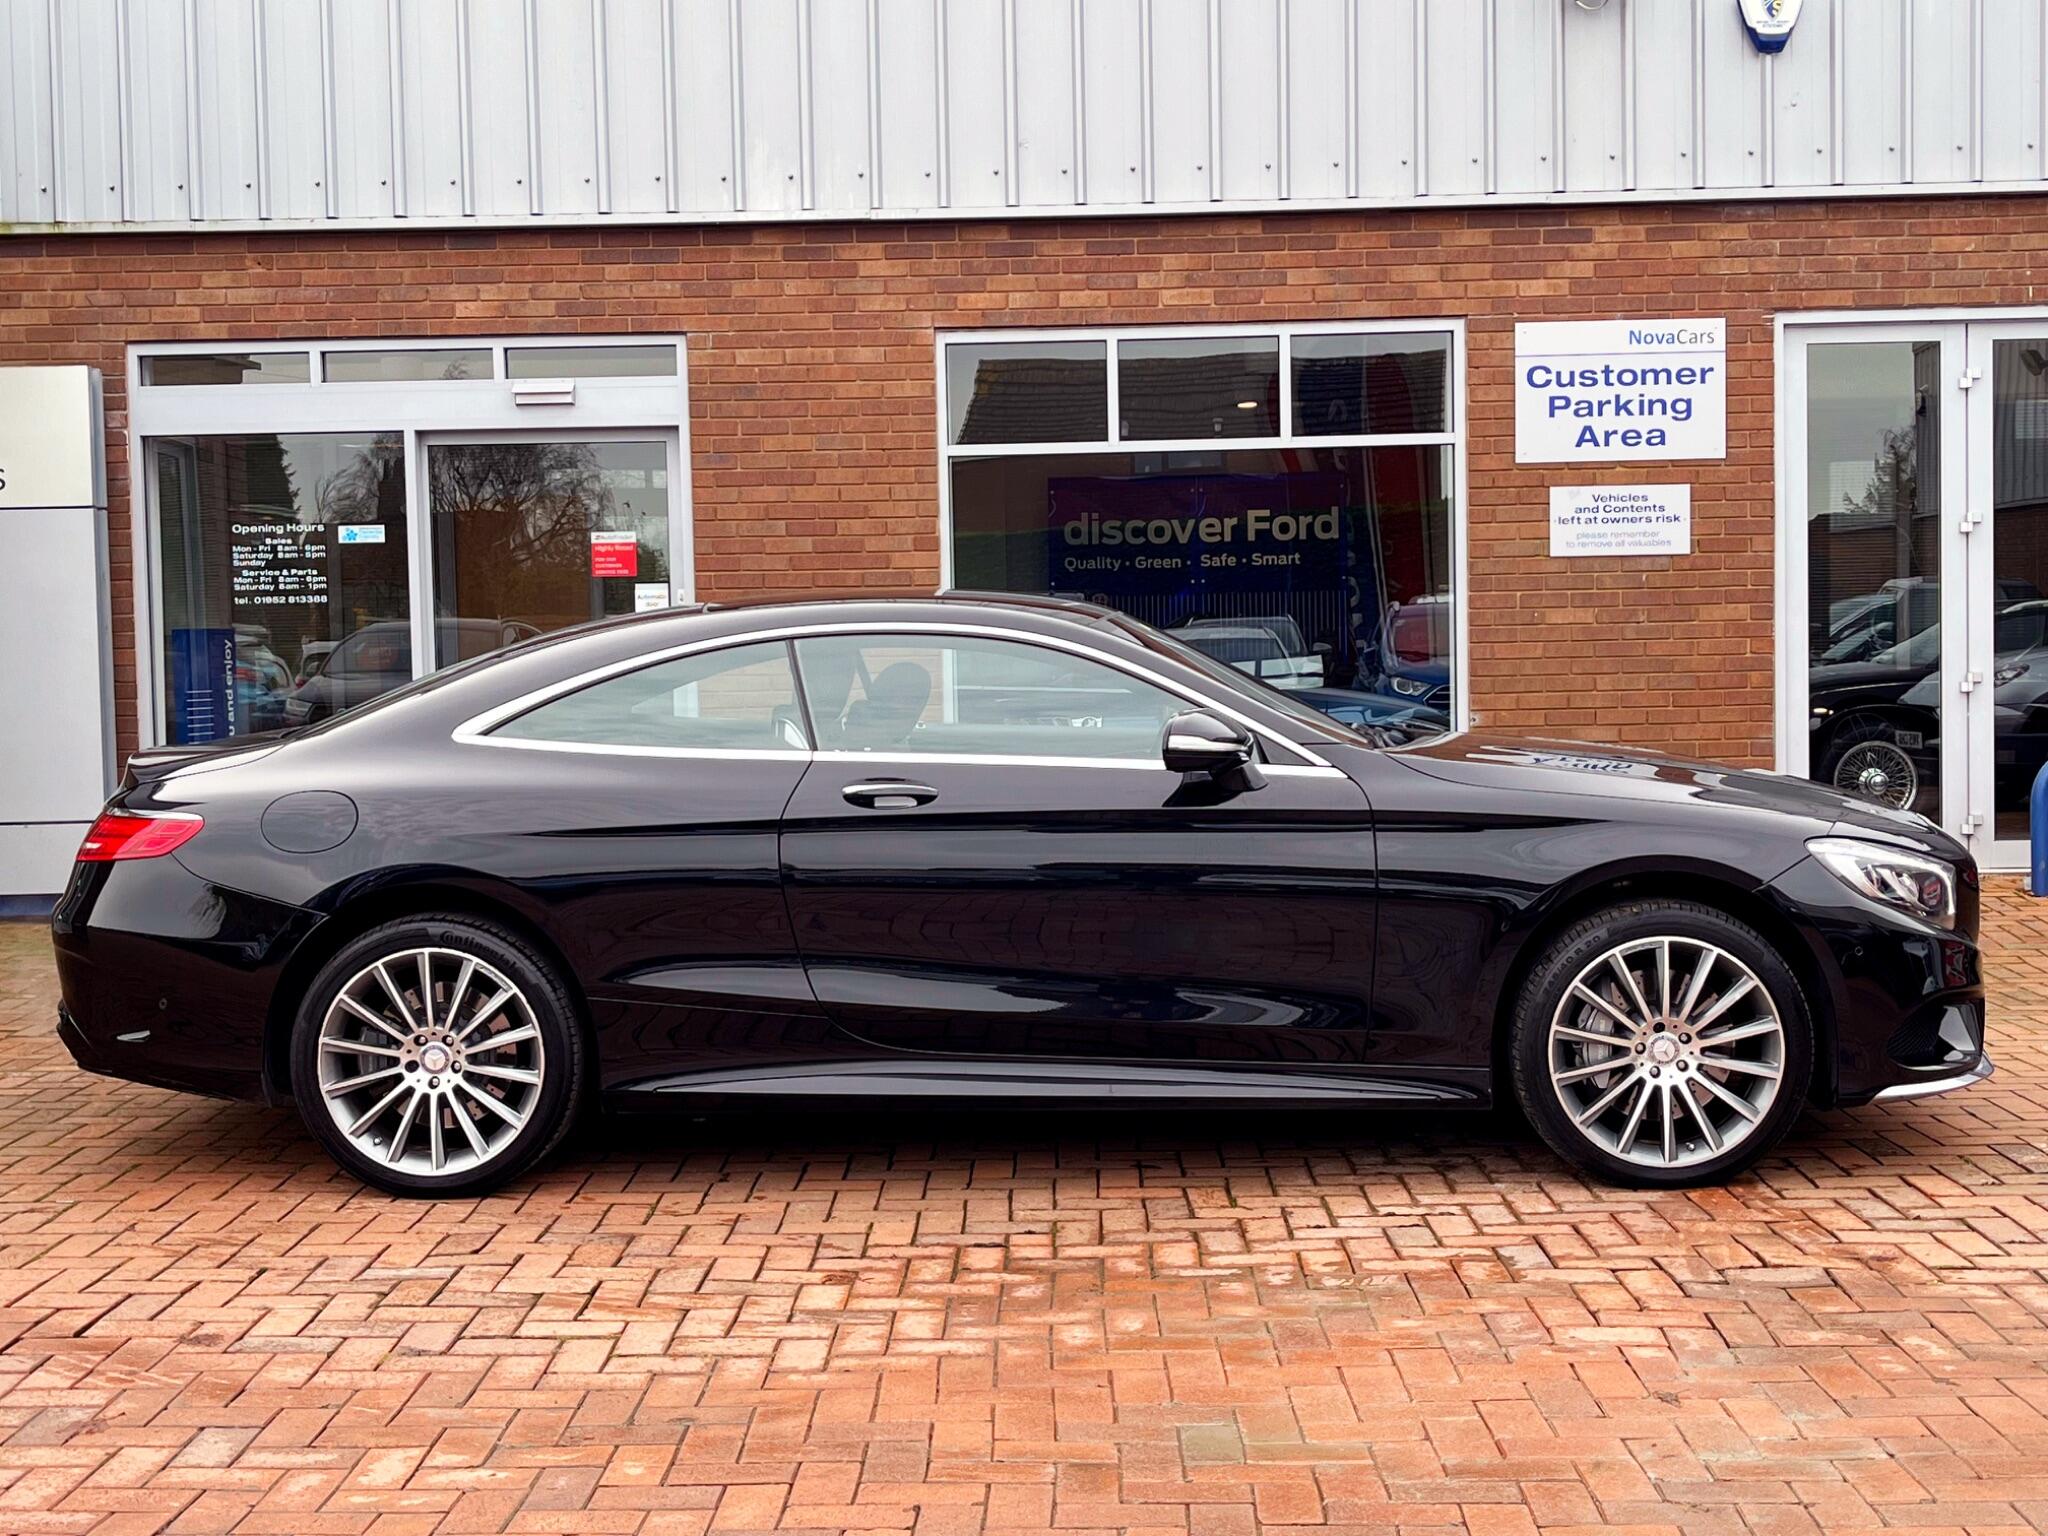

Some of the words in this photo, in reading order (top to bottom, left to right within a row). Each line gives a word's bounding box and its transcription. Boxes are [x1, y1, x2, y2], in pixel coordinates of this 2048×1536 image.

[1629, 329, 1715, 345] NovaCars
[1527, 364, 1714, 388] Customer
[1548, 394, 1693, 421] Parking
[1575, 425, 1666, 448] Area
[1592, 493, 1648, 503] Vehicles
[1574, 505, 1599, 514] and
[1603, 504, 1665, 513] Contents
[1064, 512, 1238, 545] discover
[1247, 506, 1340, 542] Ford
[1558, 516, 1581, 525] left
[1585, 516, 1598, 525] at
[1601, 516, 1652, 524] owners
[1656, 514, 1681, 523] risk
[232, 523, 284, 535] Opening
[286, 523, 325, 533] Hours
[1576, 531, 1608, 540] please
[1610, 530, 1660, 539] remember
[265, 537, 292, 545] Sales
[1566, 540, 1575, 548] to
[1577, 540, 1613, 548] remove
[1628, 539, 1672, 547] valuables
[232, 552, 273, 560] Saturday
[1064, 556, 1122, 571] Quality
[1135, 555, 1182, 568] Green
[1200, 553, 1237, 567] Safe
[1251, 551, 1301, 566] Smart
[234, 596, 251, 604] tel.
[224, 639, 234, 686] enjoy
[225, 689, 235, 722] and
